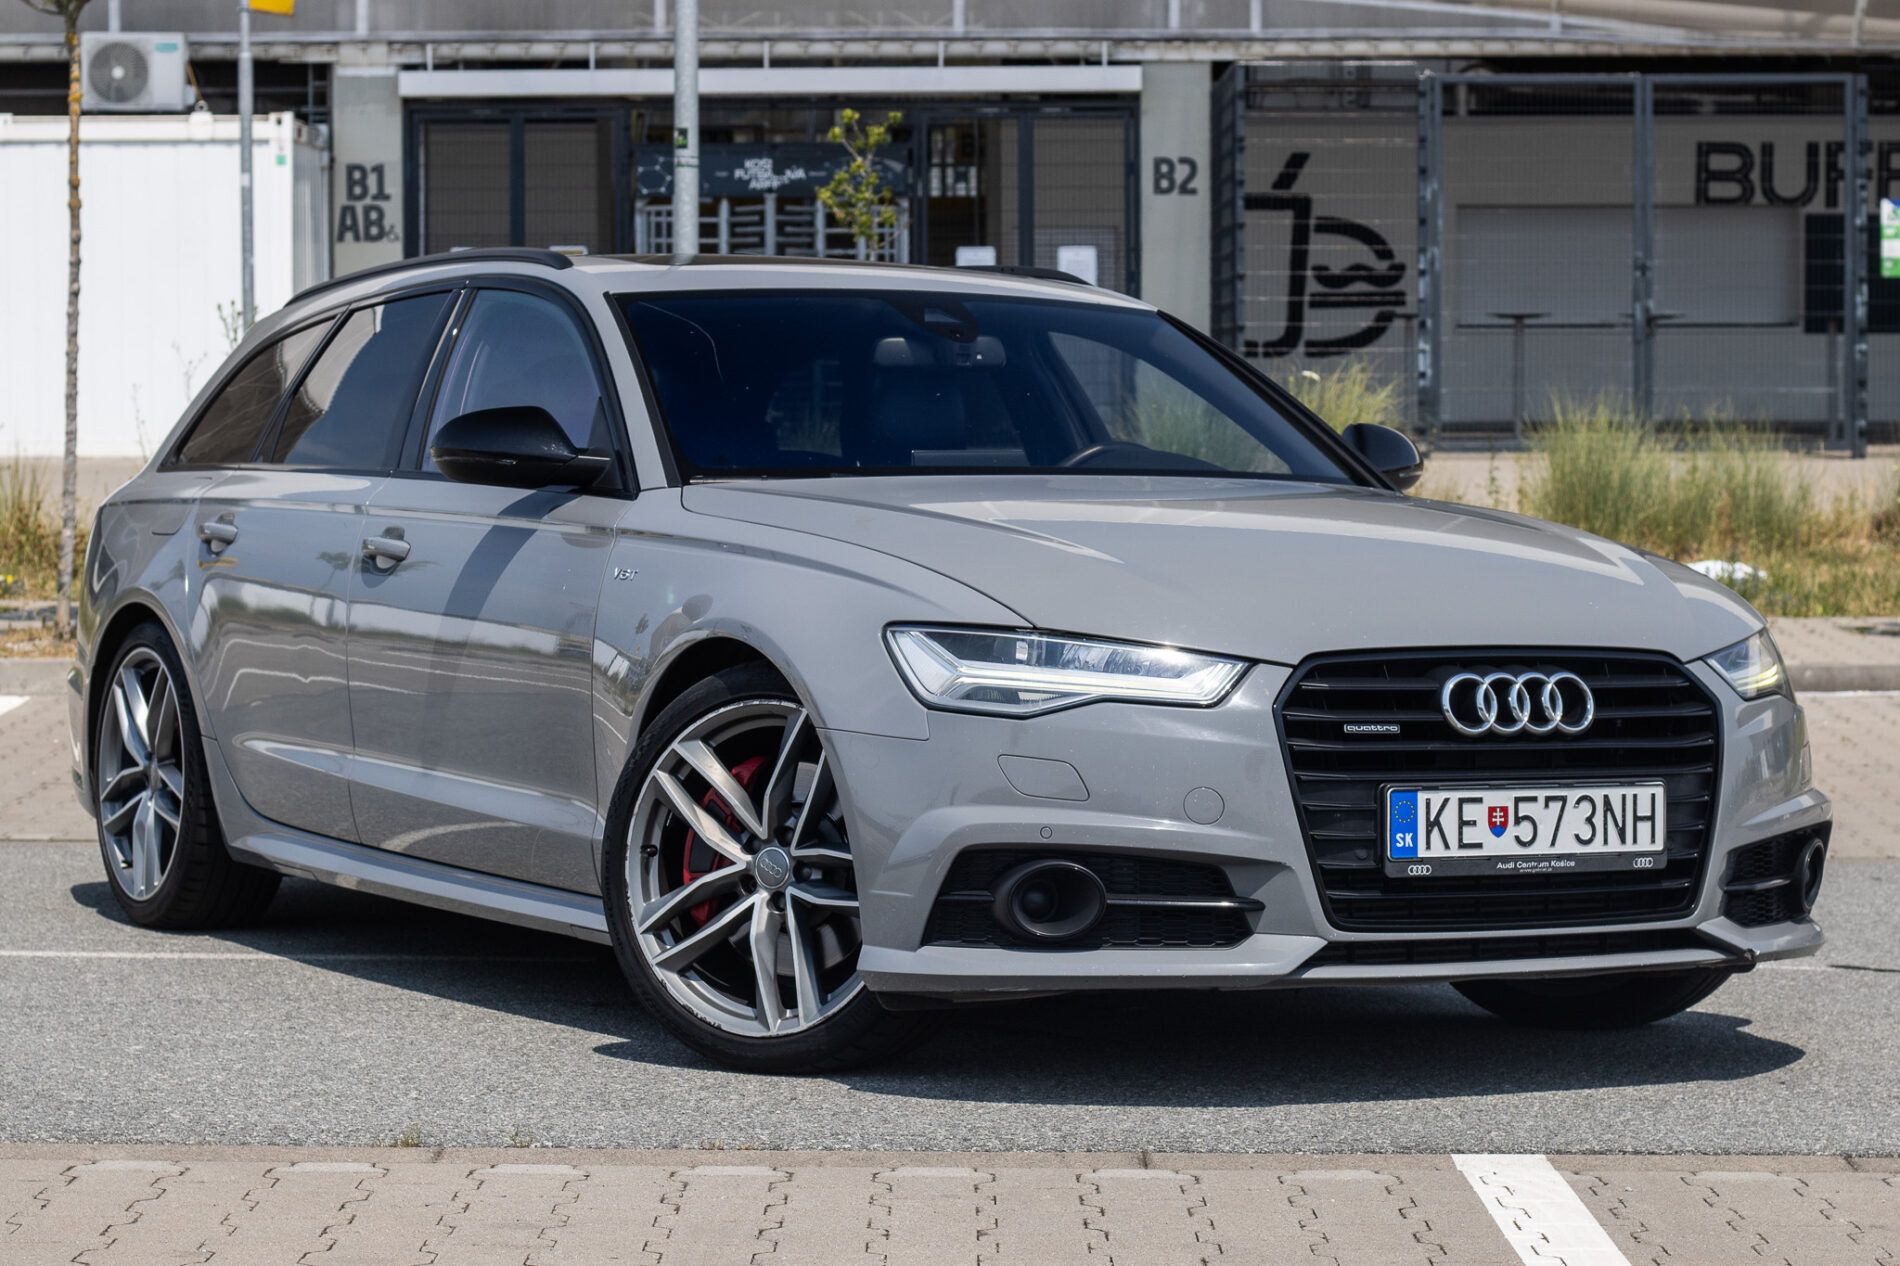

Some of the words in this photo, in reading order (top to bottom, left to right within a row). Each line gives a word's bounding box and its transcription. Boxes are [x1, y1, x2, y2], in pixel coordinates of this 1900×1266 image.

[346, 163, 391, 201] B1
[1153, 156, 1198, 195] B2
[337, 204, 385, 242] AB
[614, 567, 639, 581] V6T
[1347, 724, 1398, 732] quattro
[1395, 833, 1414, 848] SK
[1496, 861, 1515, 869] Audi
